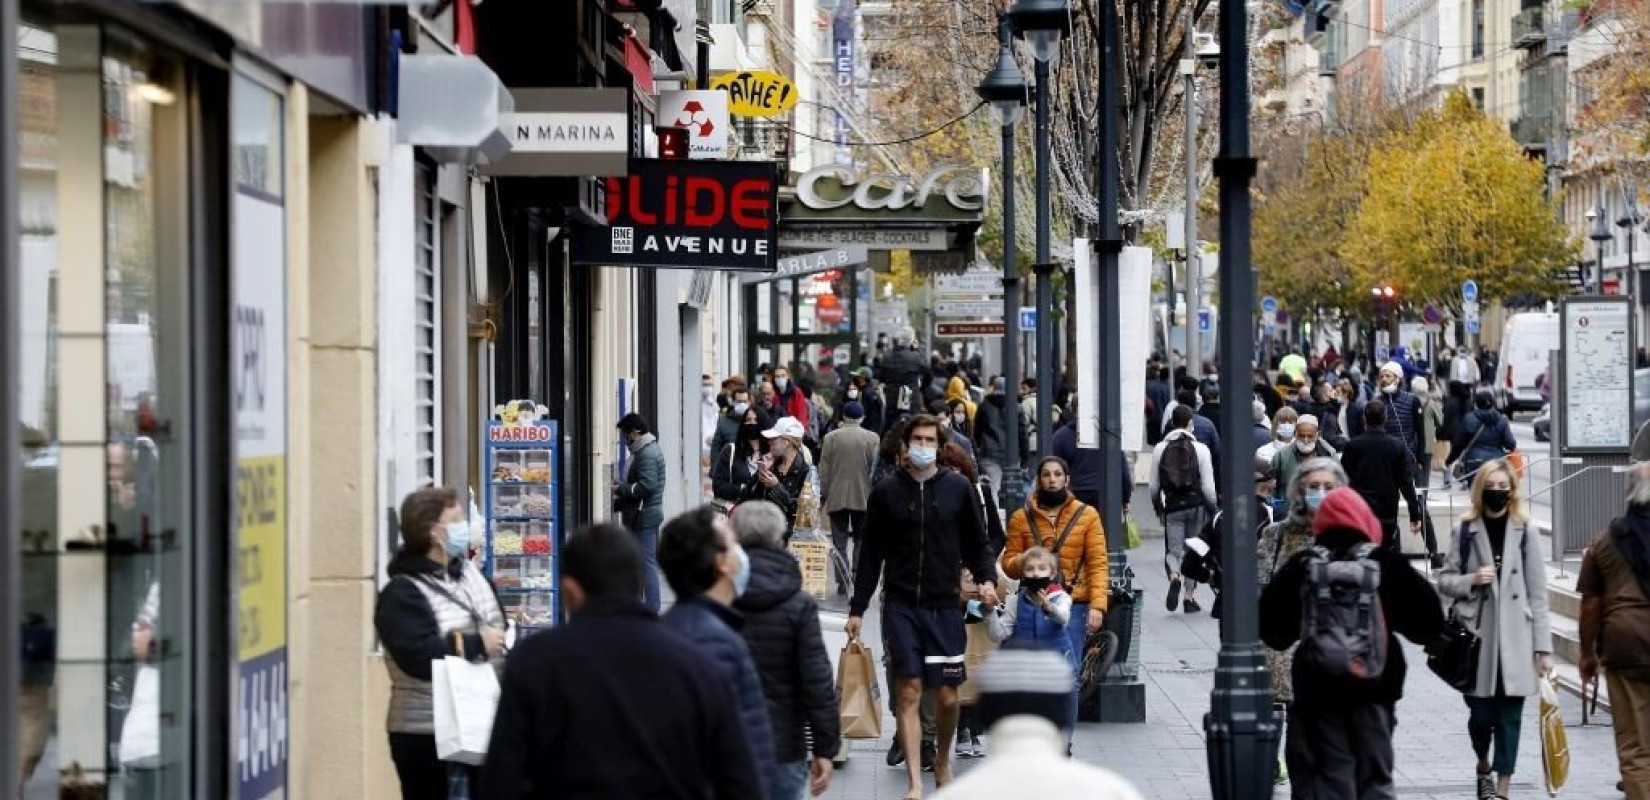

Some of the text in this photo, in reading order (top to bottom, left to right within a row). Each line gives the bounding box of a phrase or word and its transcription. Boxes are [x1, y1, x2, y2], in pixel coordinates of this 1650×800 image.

[537, 125, 615, 140] MARINA
[883, 231, 931, 244] COCKTAILS
[643, 235, 768, 256] AVENUE
[490, 426, 550, 441] HARIBO
